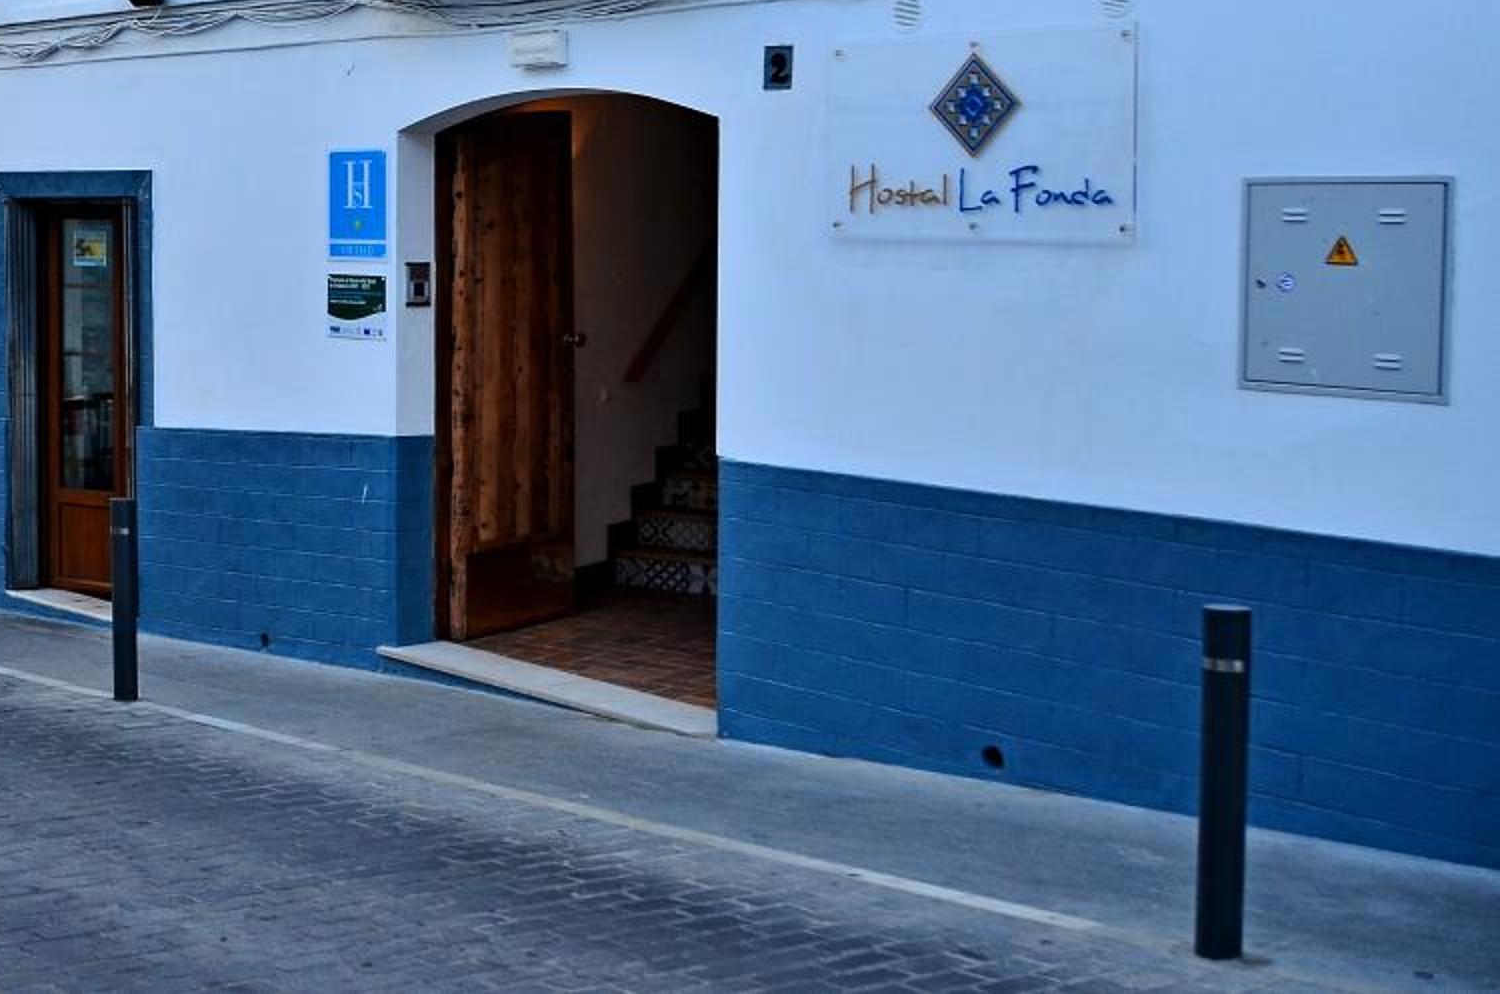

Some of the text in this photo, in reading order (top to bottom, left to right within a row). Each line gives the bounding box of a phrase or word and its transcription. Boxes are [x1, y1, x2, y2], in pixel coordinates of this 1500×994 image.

[770, 52, 788, 84] 2
[848, 163, 1115, 214] Hostal La Fonda
